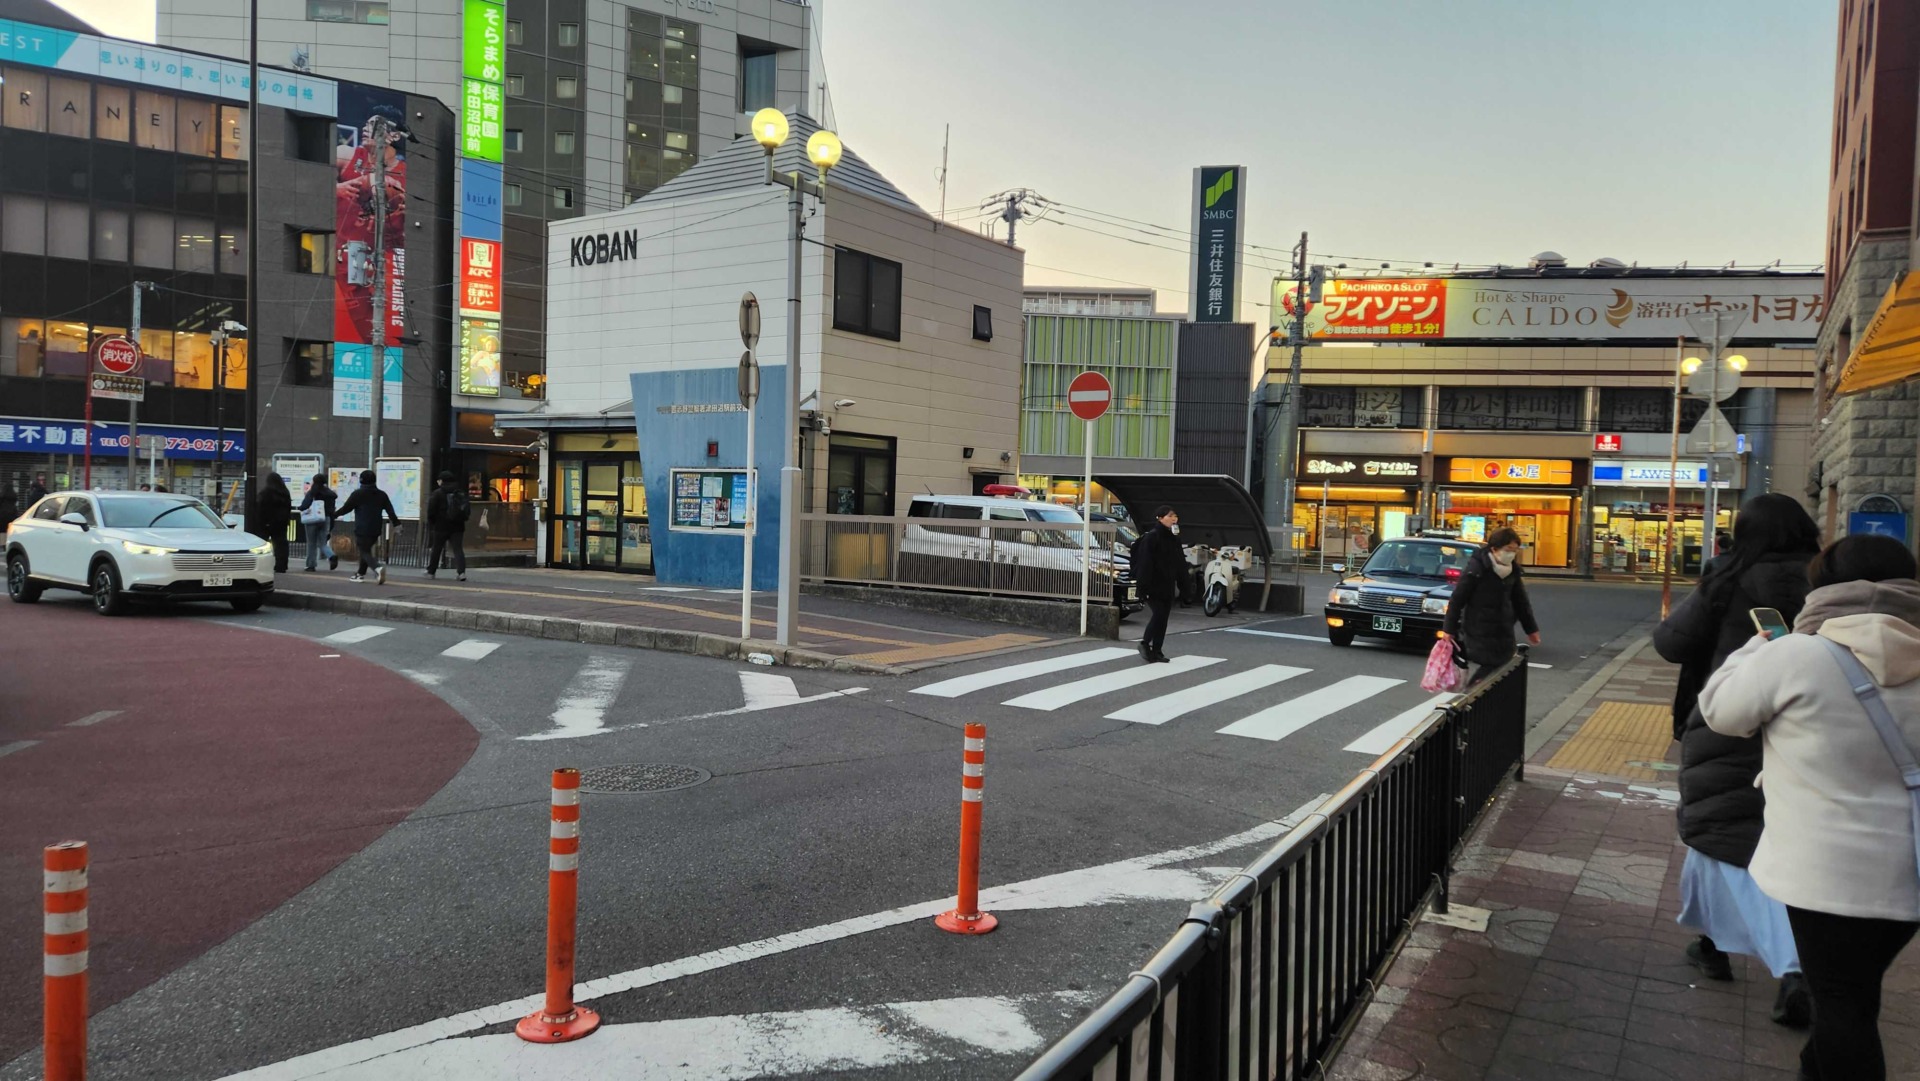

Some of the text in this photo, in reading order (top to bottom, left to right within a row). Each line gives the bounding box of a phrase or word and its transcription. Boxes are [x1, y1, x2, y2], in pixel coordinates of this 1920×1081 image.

[482, 8, 500, 139] そらまめ保育園
[466, 81, 481, 152] 津田沼駅前
[1203, 210, 1234, 220] SMBC
[570, 228, 638, 267] KOBAN
[467, 267, 493, 278] KFC
[1208, 229, 1224, 315] 三井住友銀行
[467, 288, 494, 298] 住まい
[1340, 283, 1391, 292] PACHINKO
[1400, 283, 1429, 292] SLOT
[467, 296, 494, 306] リレー
[1475, 292, 1566, 305] Hot & Shape
[1472, 306, 1598, 326] CALDO
[103, 348, 133, 364] 消火栓
[460, 320, 470, 393] キックボクシング
[101, 437, 118, 446] TEL
[1507, 464, 1540, 478] 松屋
[1630, 469, 1692, 480] LAWSON
